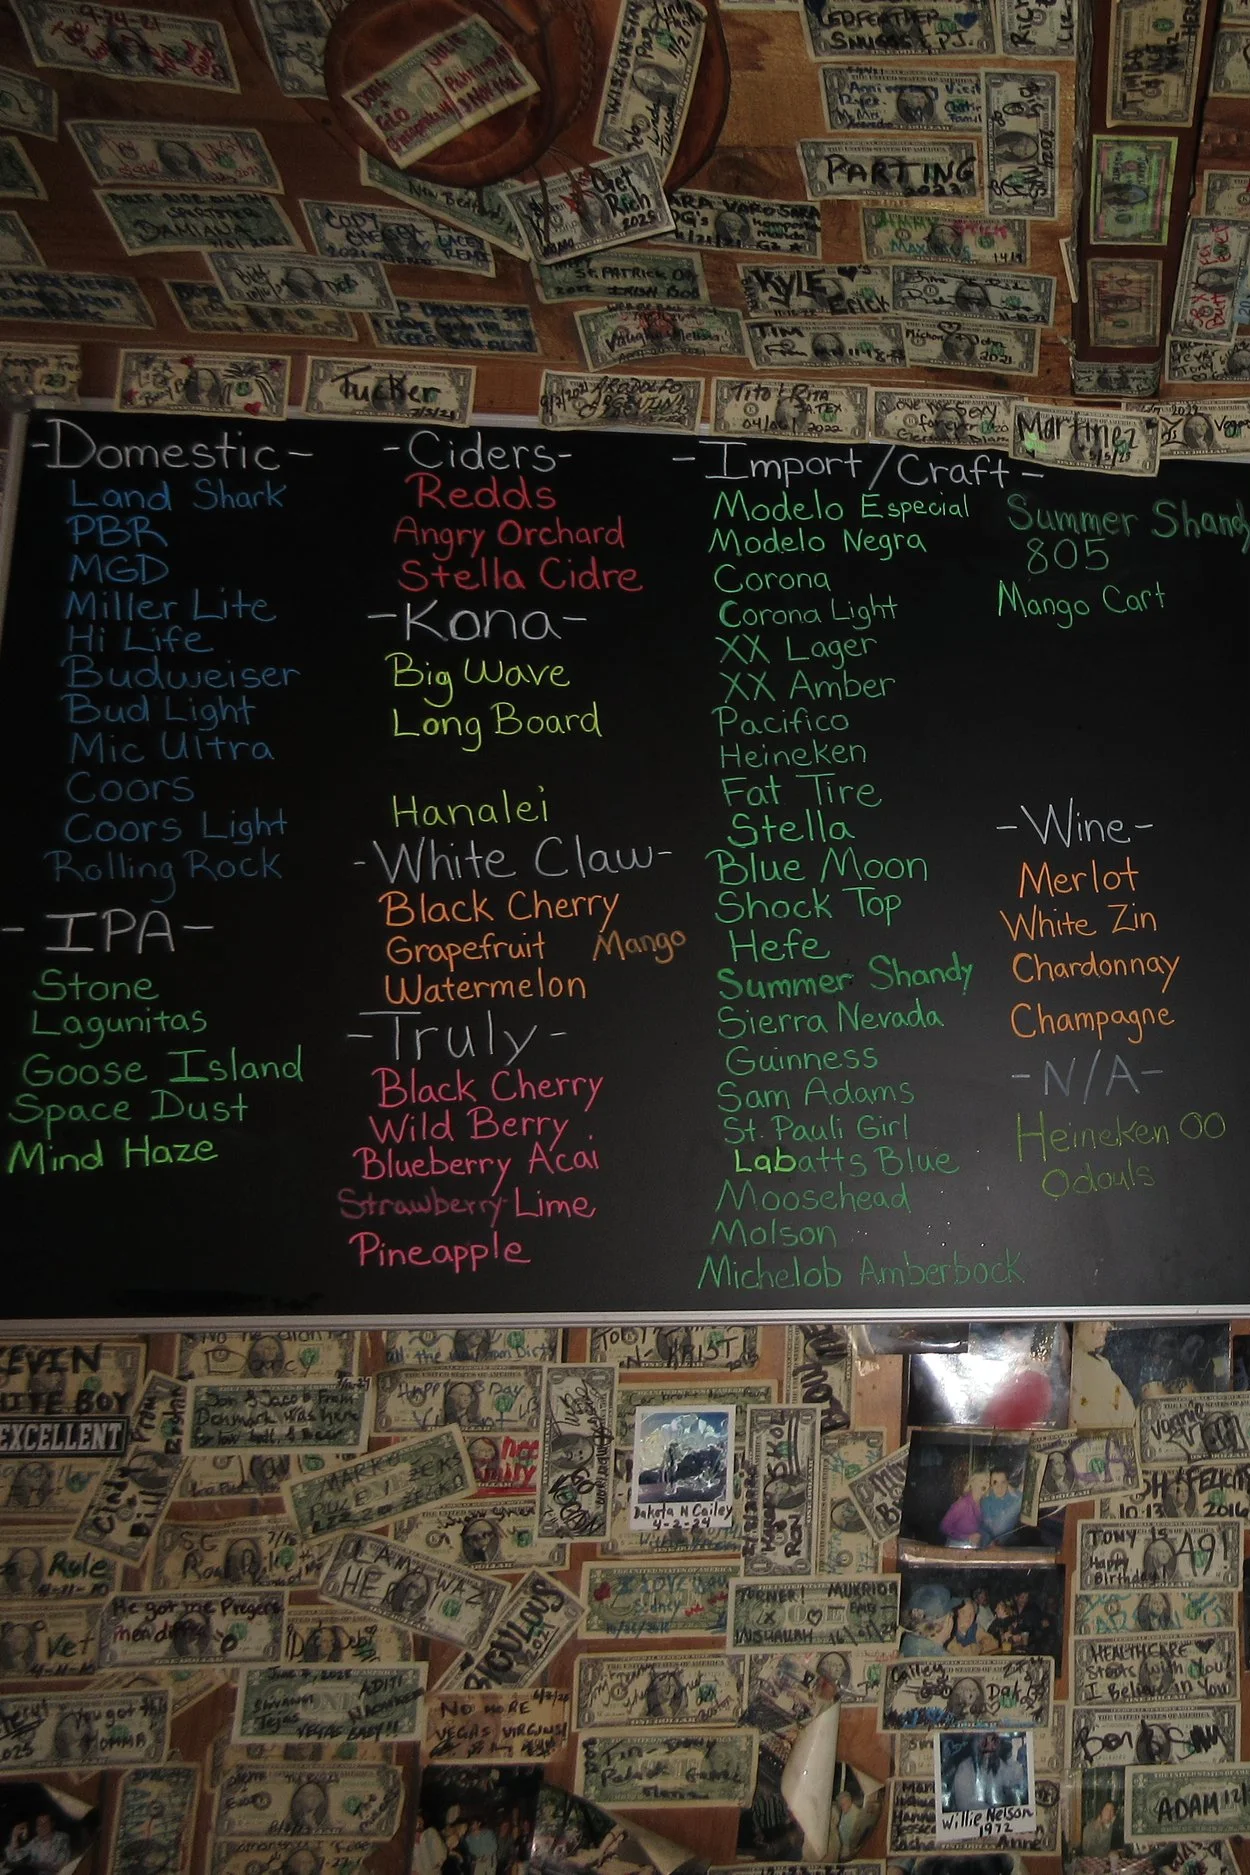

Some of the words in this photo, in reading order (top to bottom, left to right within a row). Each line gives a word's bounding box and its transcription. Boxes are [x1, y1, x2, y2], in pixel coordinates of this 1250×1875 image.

[826, 153, 976, 186] PARTING
[70, 478, 172, 511] Land
[192, 478, 287, 510] Shark
[404, 472, 557, 509] Redds
[712, 489, 844, 522] Modelo
[860, 492, 970, 521] Especial
[65, 514, 168, 547] PBR
[393, 515, 486, 561] Angry
[496, 515, 626, 548] Orchard
[708, 527, 826, 556] Modelo
[843, 527, 928, 561] Negra
[68, 553, 170, 585] MGD
[398, 557, 526, 592] Stella
[539, 556, 644, 592] Cidre
[1026, 537, 1111, 577] 805
[713, 563, 832, 593] Corona
[64, 591, 178, 621] Miller
[192, 586, 277, 622] Lite
[997, 578, 1091, 630] Mango
[1101, 582, 1167, 615] Cart
[60, 654, 302, 689] Budweiser
[385, 652, 453, 708] Big
[464, 656, 571, 687] Wave
[711, 705, 850, 737] Pacifico
[719, 742, 868, 769] Heineken
[66, 771, 195, 803] Coors
[392, 785, 550, 829] Hanalei
[43, 849, 176, 903] Rolling
[183, 847, 282, 880] Rock
[705, 848, 806, 886] Blue
[820, 845, 930, 883] Moon
[1018, 856, 1140, 900] Merlot
[1000, 905, 1098, 944] White
[1107, 903, 1159, 935] Zin
[386, 931, 546, 972] Grapefruit
[729, 929, 831, 964] Hefe
[32, 969, 159, 1001] Stone
[384, 967, 587, 1006] Watermelon
[1012, 952, 1181, 995] Chardonnay
[32, 1008, 208, 1050] Lagunitas
[717, 1005, 828, 1041] Sierra
[837, 998, 944, 1032] Nevada
[1010, 1002, 1176, 1046] Champagne
[23, 1053, 147, 1087] Goose
[167, 1044, 304, 1084] Island
[368, 1113, 454, 1144] Wild
[466, 1105, 570, 1152] Berry
[7, 1139, 103, 1175] Mind
[124, 1135, 219, 1169] Haze
[348, 1230, 532, 1275] Pineapple
[0, 1421, 125, 1453] EXCELLENT
[634, 1504, 677, 1520] Dakota
[692, 1503, 733, 1526] Cailey
[1089, 1530, 1136, 1548] TONY
[1091, 1556, 1129, 1572] Happy
[941, 1810, 982, 1833] Willie
[986, 1807, 1034, 1821] Nelson
[1158, 1791, 1221, 1821] ADAM
[977, 1822, 1013, 1835] 1972
